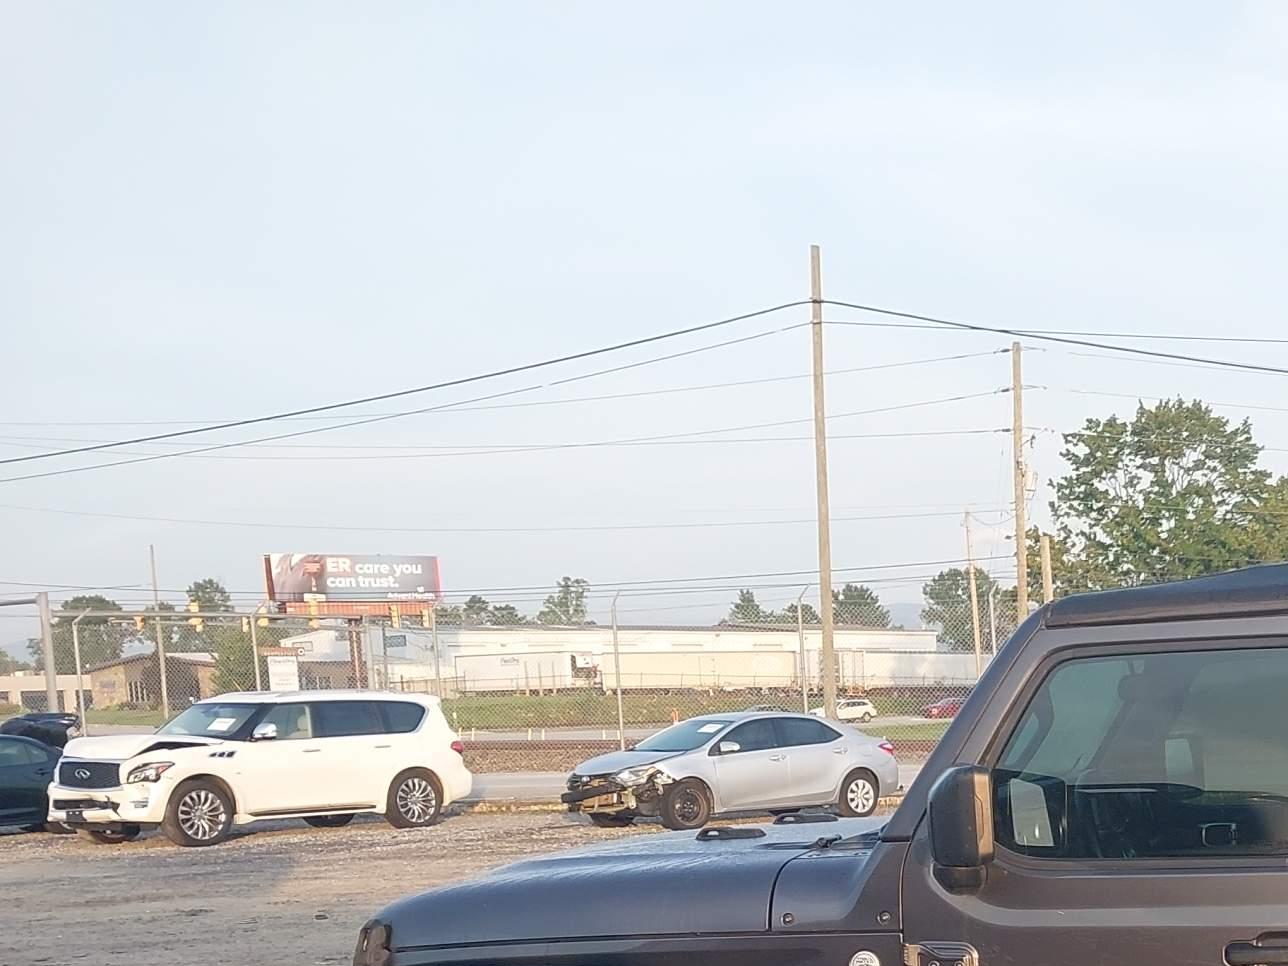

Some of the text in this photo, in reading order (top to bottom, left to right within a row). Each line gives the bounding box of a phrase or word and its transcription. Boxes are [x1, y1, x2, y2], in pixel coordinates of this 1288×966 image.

[327, 557, 351, 572] ER
[355, 564, 389, 574] care
[393, 564, 422, 577] you
[326, 576, 399, 588] can trust.
